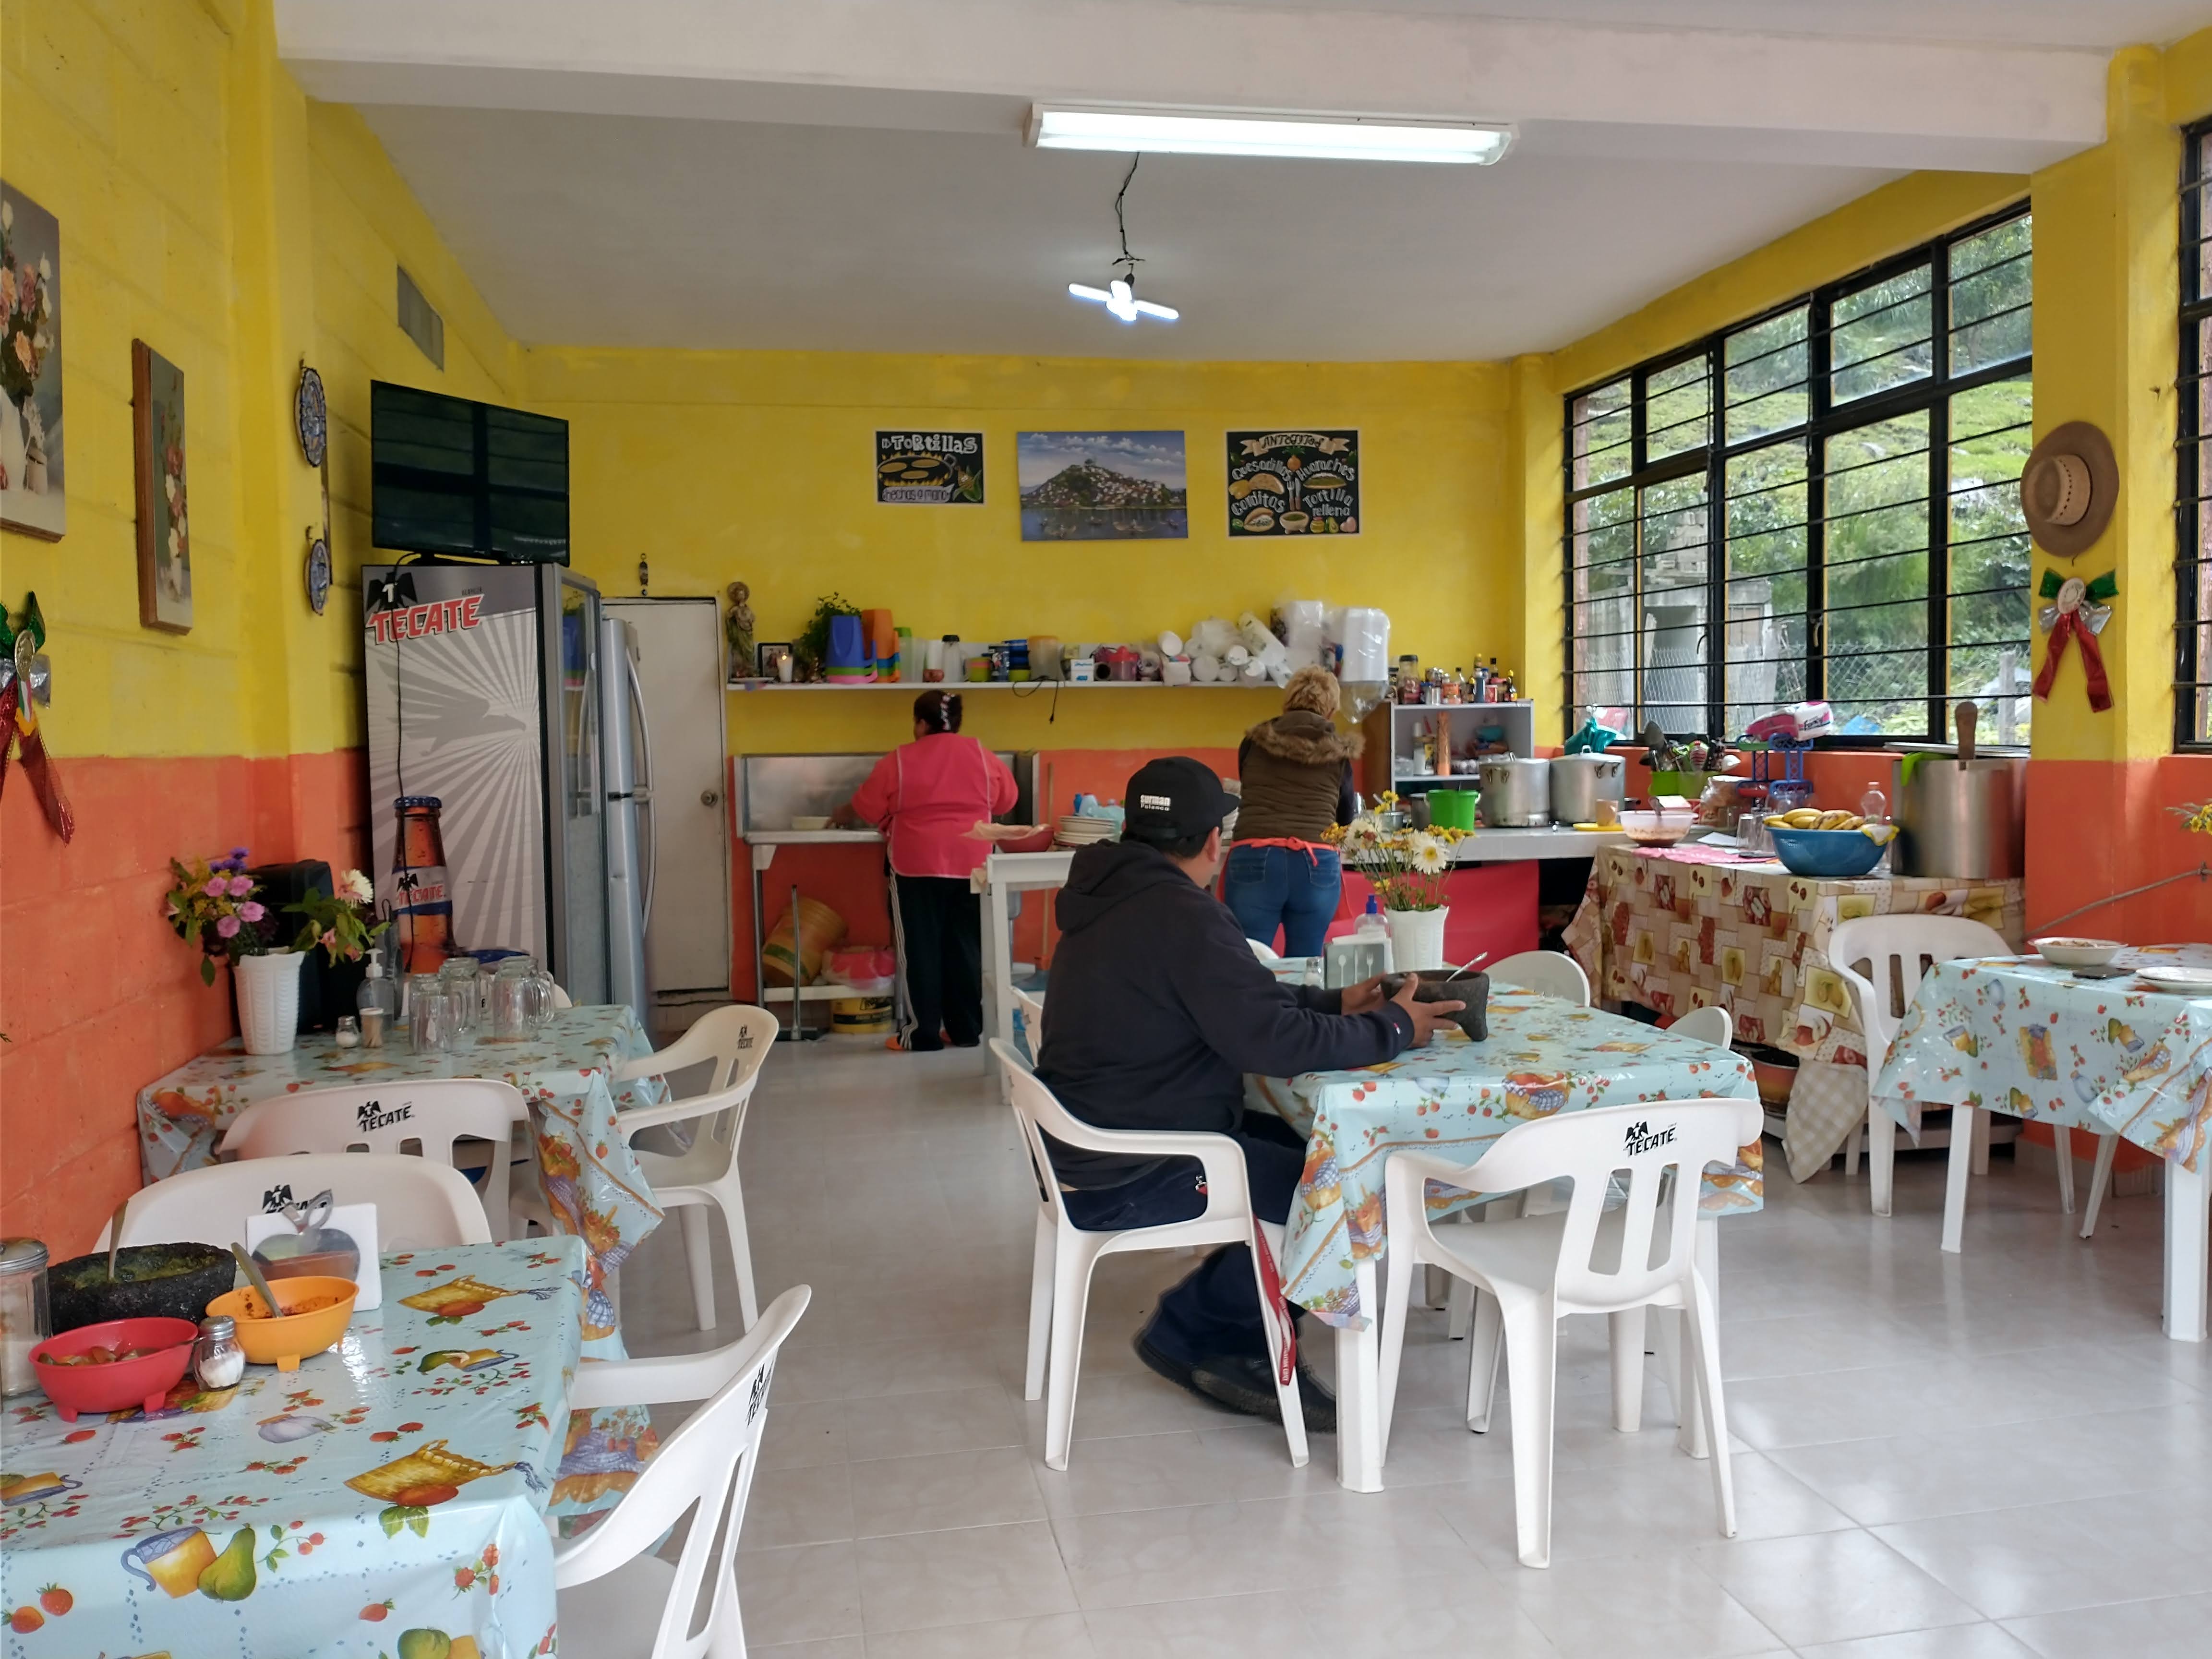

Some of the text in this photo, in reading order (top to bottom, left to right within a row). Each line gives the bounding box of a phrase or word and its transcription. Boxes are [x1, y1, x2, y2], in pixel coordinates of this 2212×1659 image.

[1231, 458, 1292, 482] Quesadillas
[1296, 458, 1355, 481] Huaraches
[1231, 491, 1286, 516] Gorditas
[1302, 489, 1354, 508] Tortilla
[1312, 504, 1350, 516] rellena
[365, 594, 485, 645] TECATE
[357, 1105, 412, 1133] TECATE
[1623, 1127, 1676, 1157] TECATE
